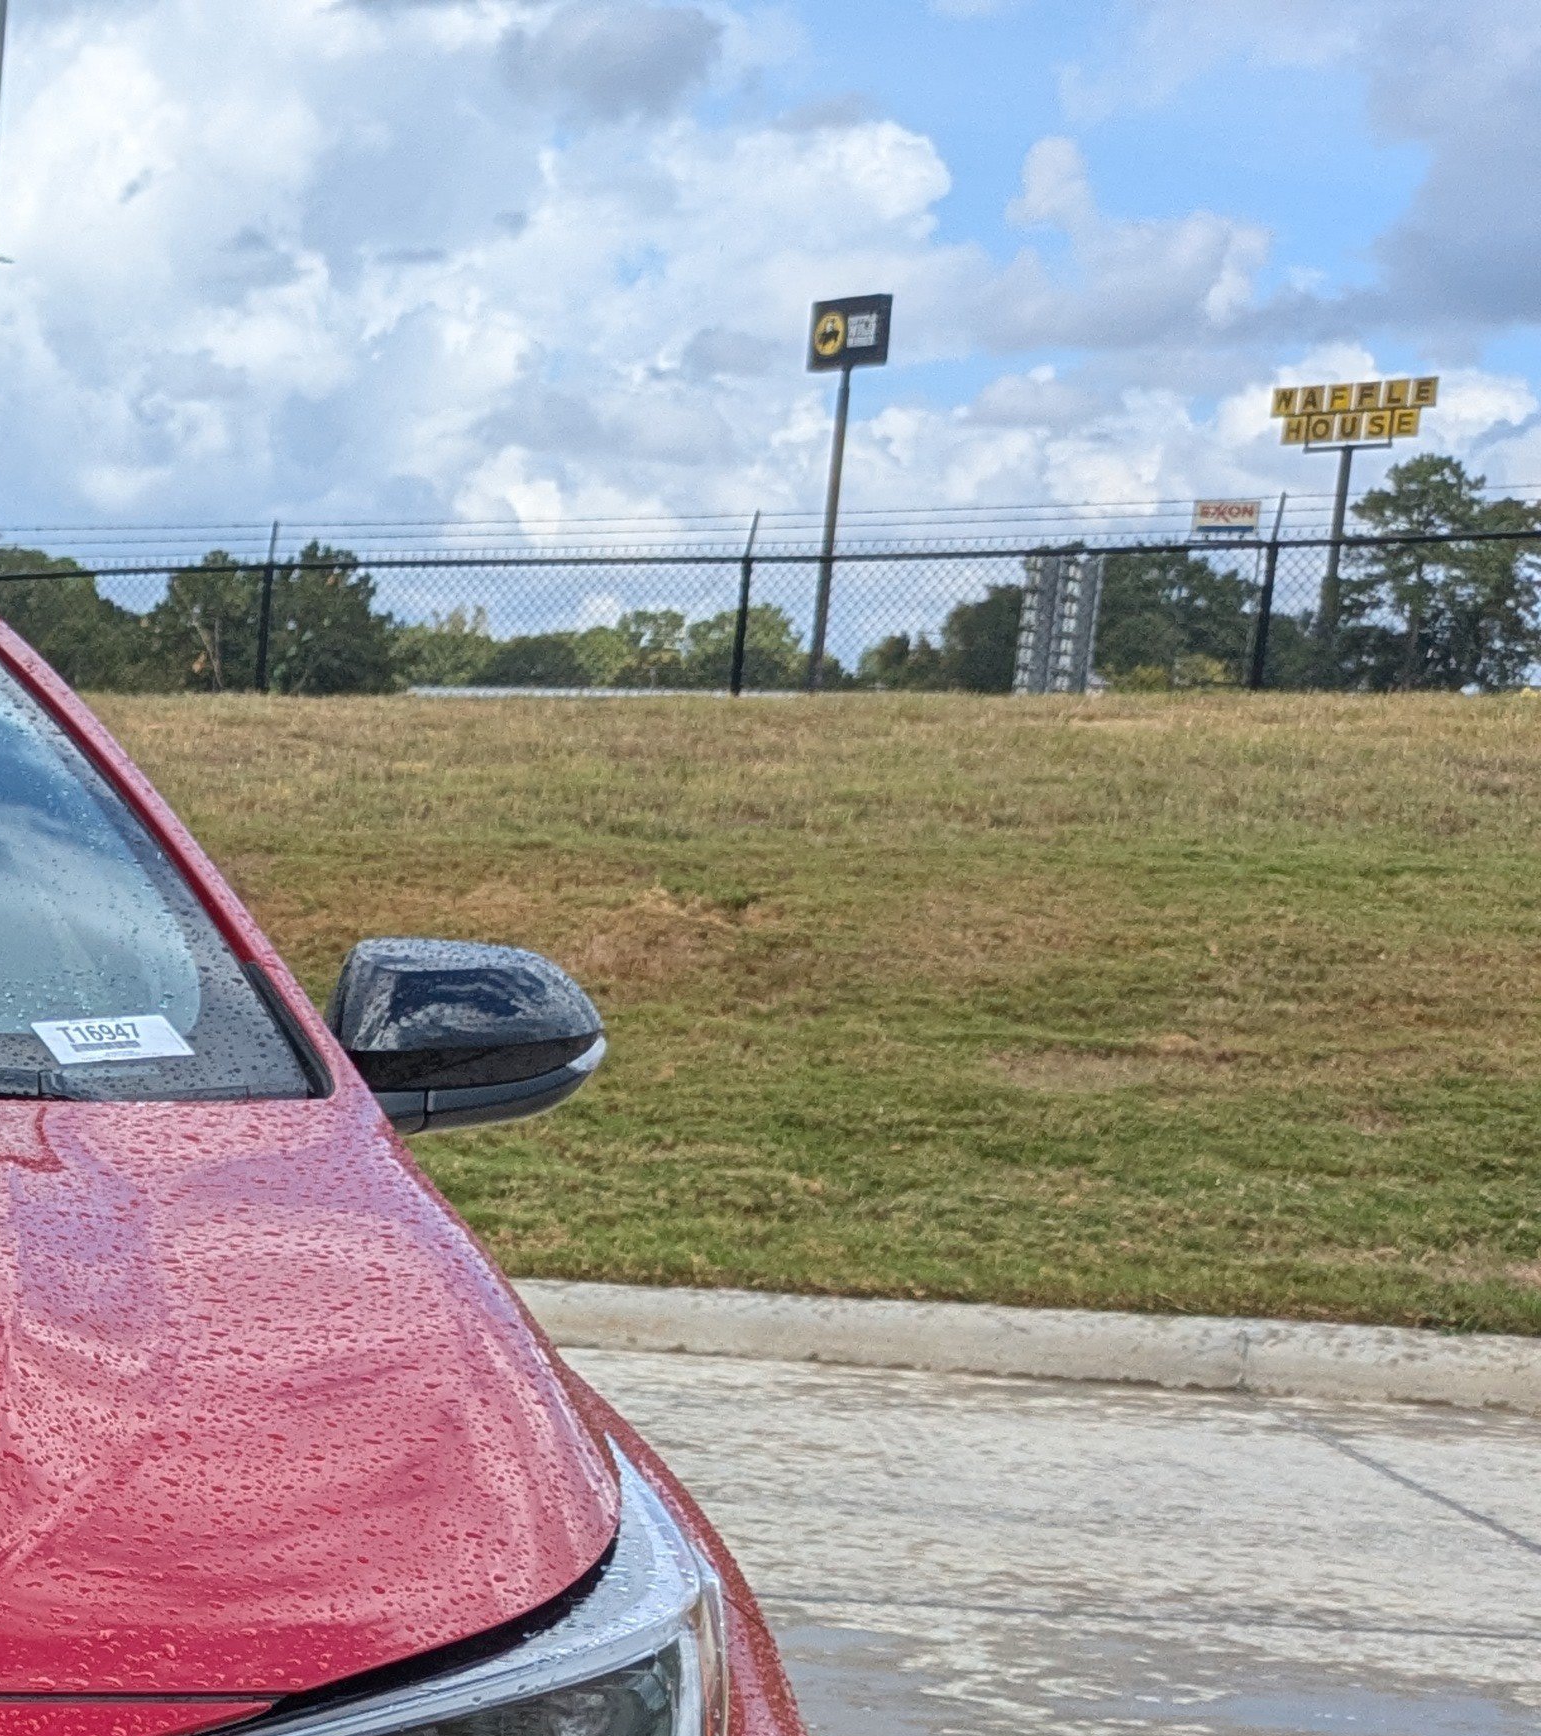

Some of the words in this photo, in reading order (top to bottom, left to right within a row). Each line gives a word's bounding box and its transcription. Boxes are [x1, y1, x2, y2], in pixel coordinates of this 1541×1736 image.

[1275, 380, 1431, 411] WAFFLE
[1286, 411, 1415, 441] HOUSE
[1200, 503, 1254, 523] EXXON
[56, 1022, 141, 1044] T16947
